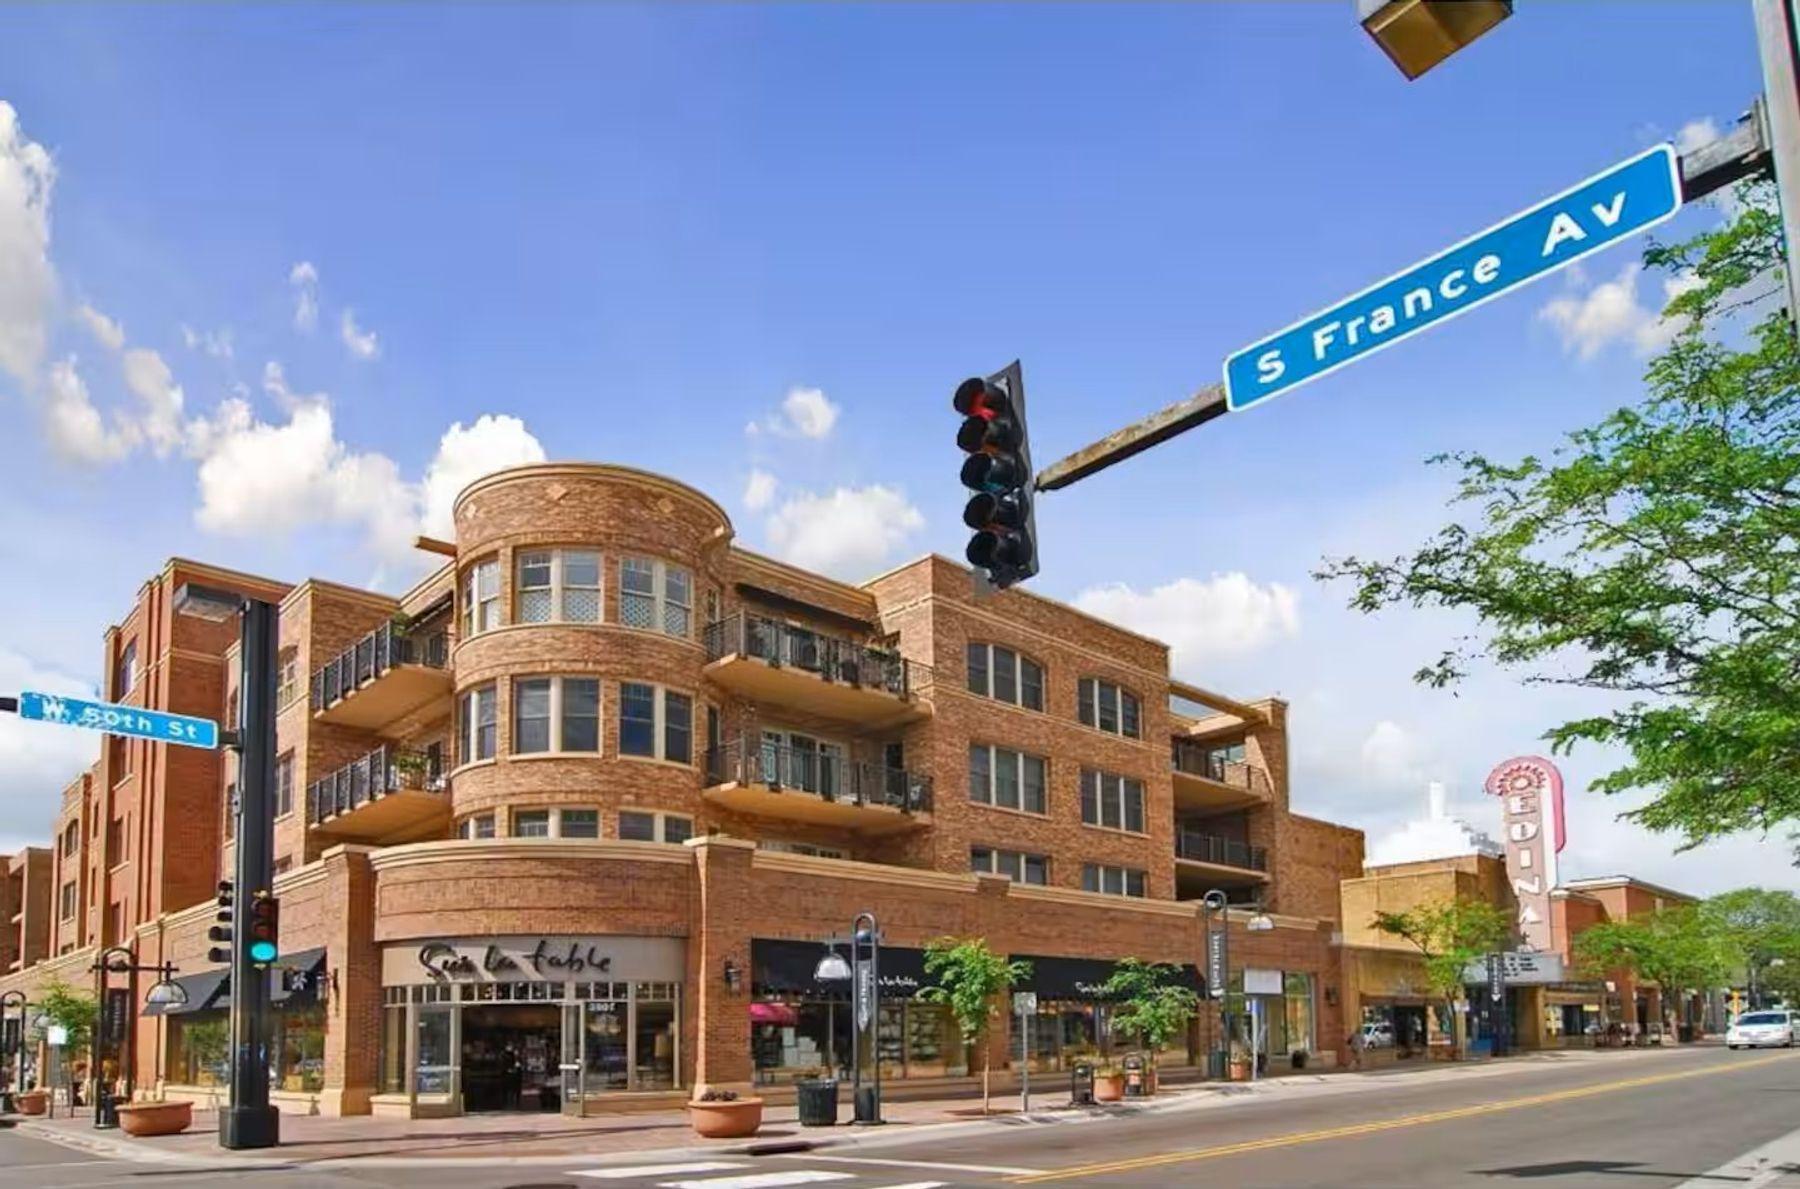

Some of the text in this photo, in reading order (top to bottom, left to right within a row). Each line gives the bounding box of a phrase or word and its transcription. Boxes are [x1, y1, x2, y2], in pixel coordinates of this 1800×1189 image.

[1257, 191, 1627, 384] S France Av
[82, 706, 152, 732] 50th
[168, 720, 197, 739] St
[1509, 792, 1542, 924] EDINA
[523, 940, 612, 973] table
